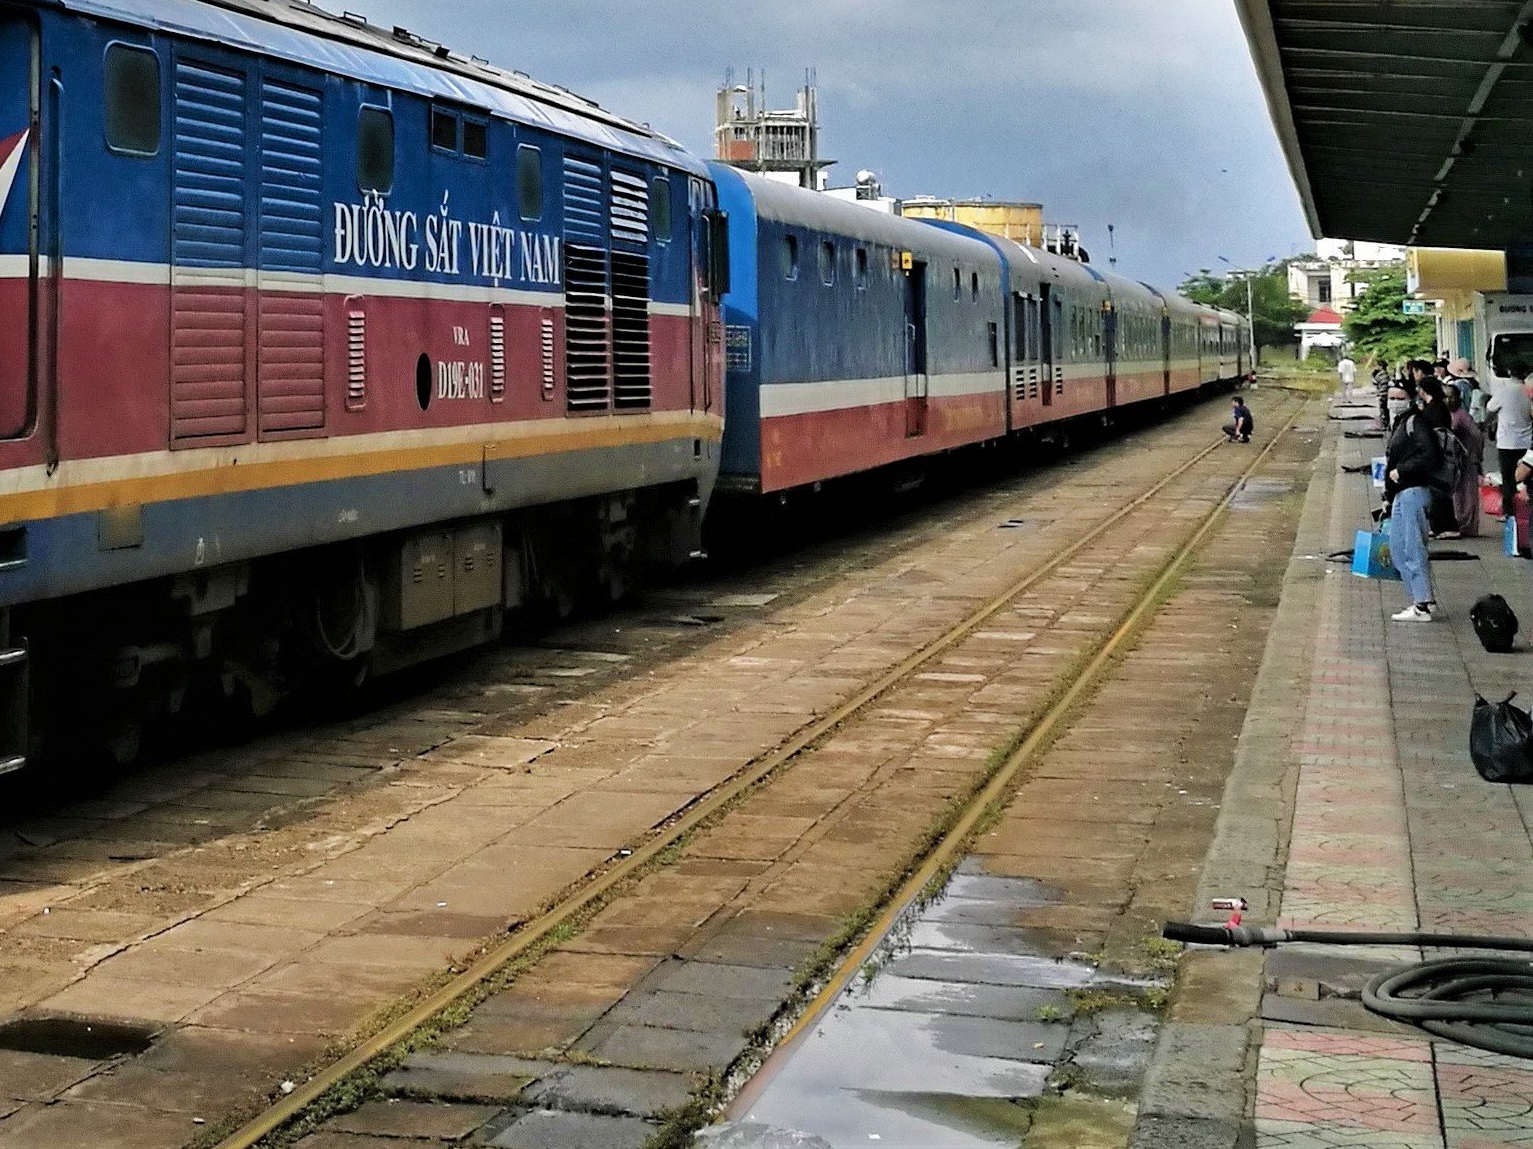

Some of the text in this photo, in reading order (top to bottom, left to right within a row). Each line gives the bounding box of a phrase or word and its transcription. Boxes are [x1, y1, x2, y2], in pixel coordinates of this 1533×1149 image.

[333, 188, 561, 287] ĐƯỜNG SẮT VIỆT NAM
[437, 360, 484, 400] D19E-031
